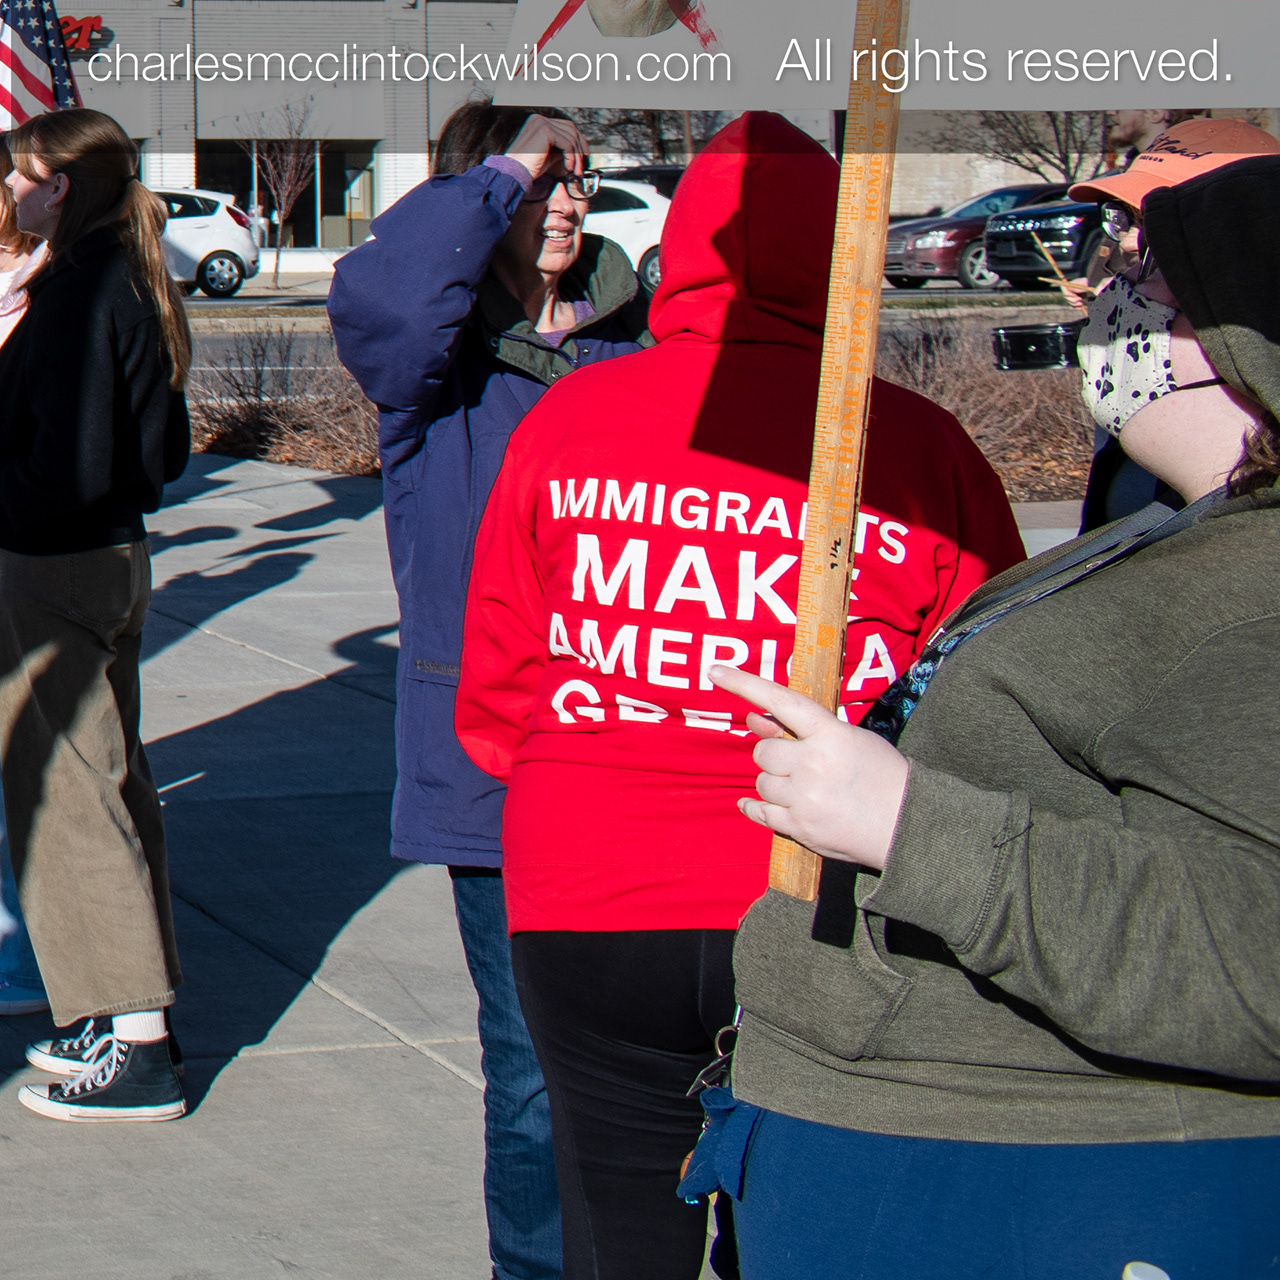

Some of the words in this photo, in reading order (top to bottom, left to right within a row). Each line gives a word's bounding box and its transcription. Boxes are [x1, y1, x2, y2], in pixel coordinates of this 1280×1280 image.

[871, 117, 889, 149] OF
[864, 153, 885, 221] HOME
[847, 281, 872, 374] DEPOT
[838, 381, 862, 465] HOME
[549, 476, 909, 566] IMMIGRATS
[831, 472, 853, 527] THE
[571, 532, 862, 626] MAK
[549, 612, 898, 692] AMERIA
